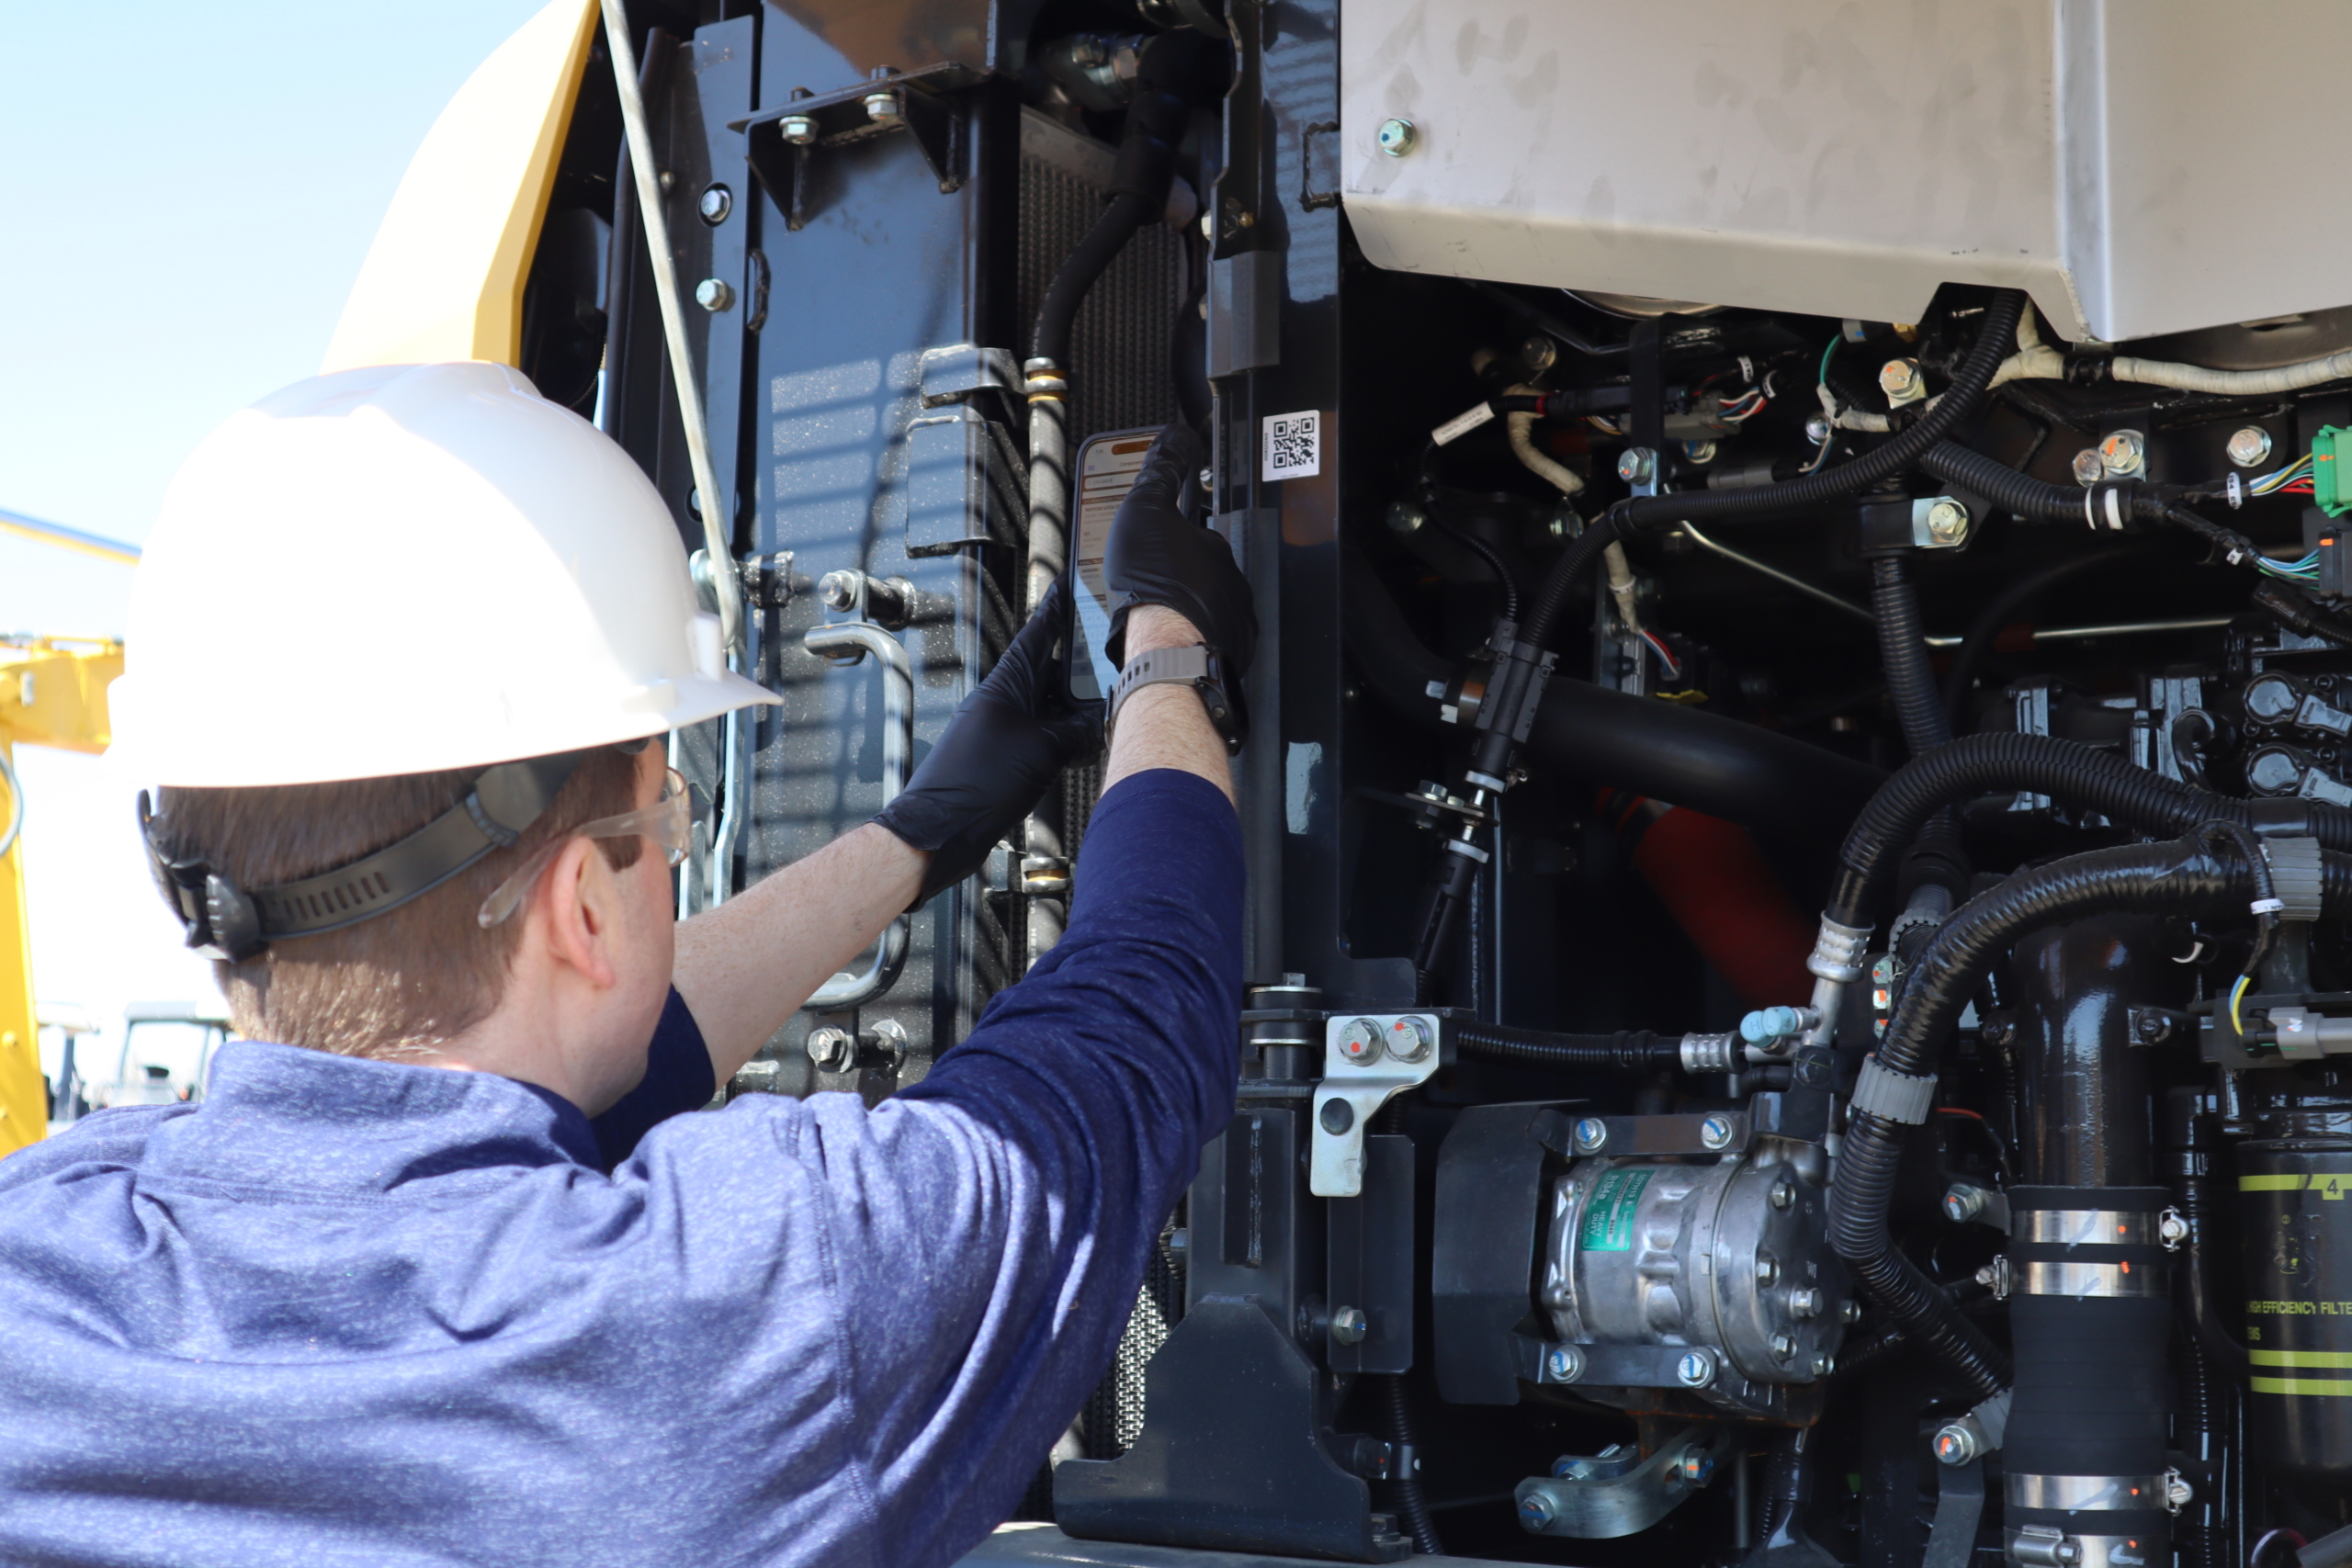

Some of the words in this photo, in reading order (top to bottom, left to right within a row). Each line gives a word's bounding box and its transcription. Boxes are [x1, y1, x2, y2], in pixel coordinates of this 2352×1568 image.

[2326, 1179, 2339, 1196] 4
[1589, 1213, 1600, 1236] DUTY
[1595, 1211, 1607, 1238] HEAVY
[2262, 1301, 2317, 1315] EFFICIENCY
